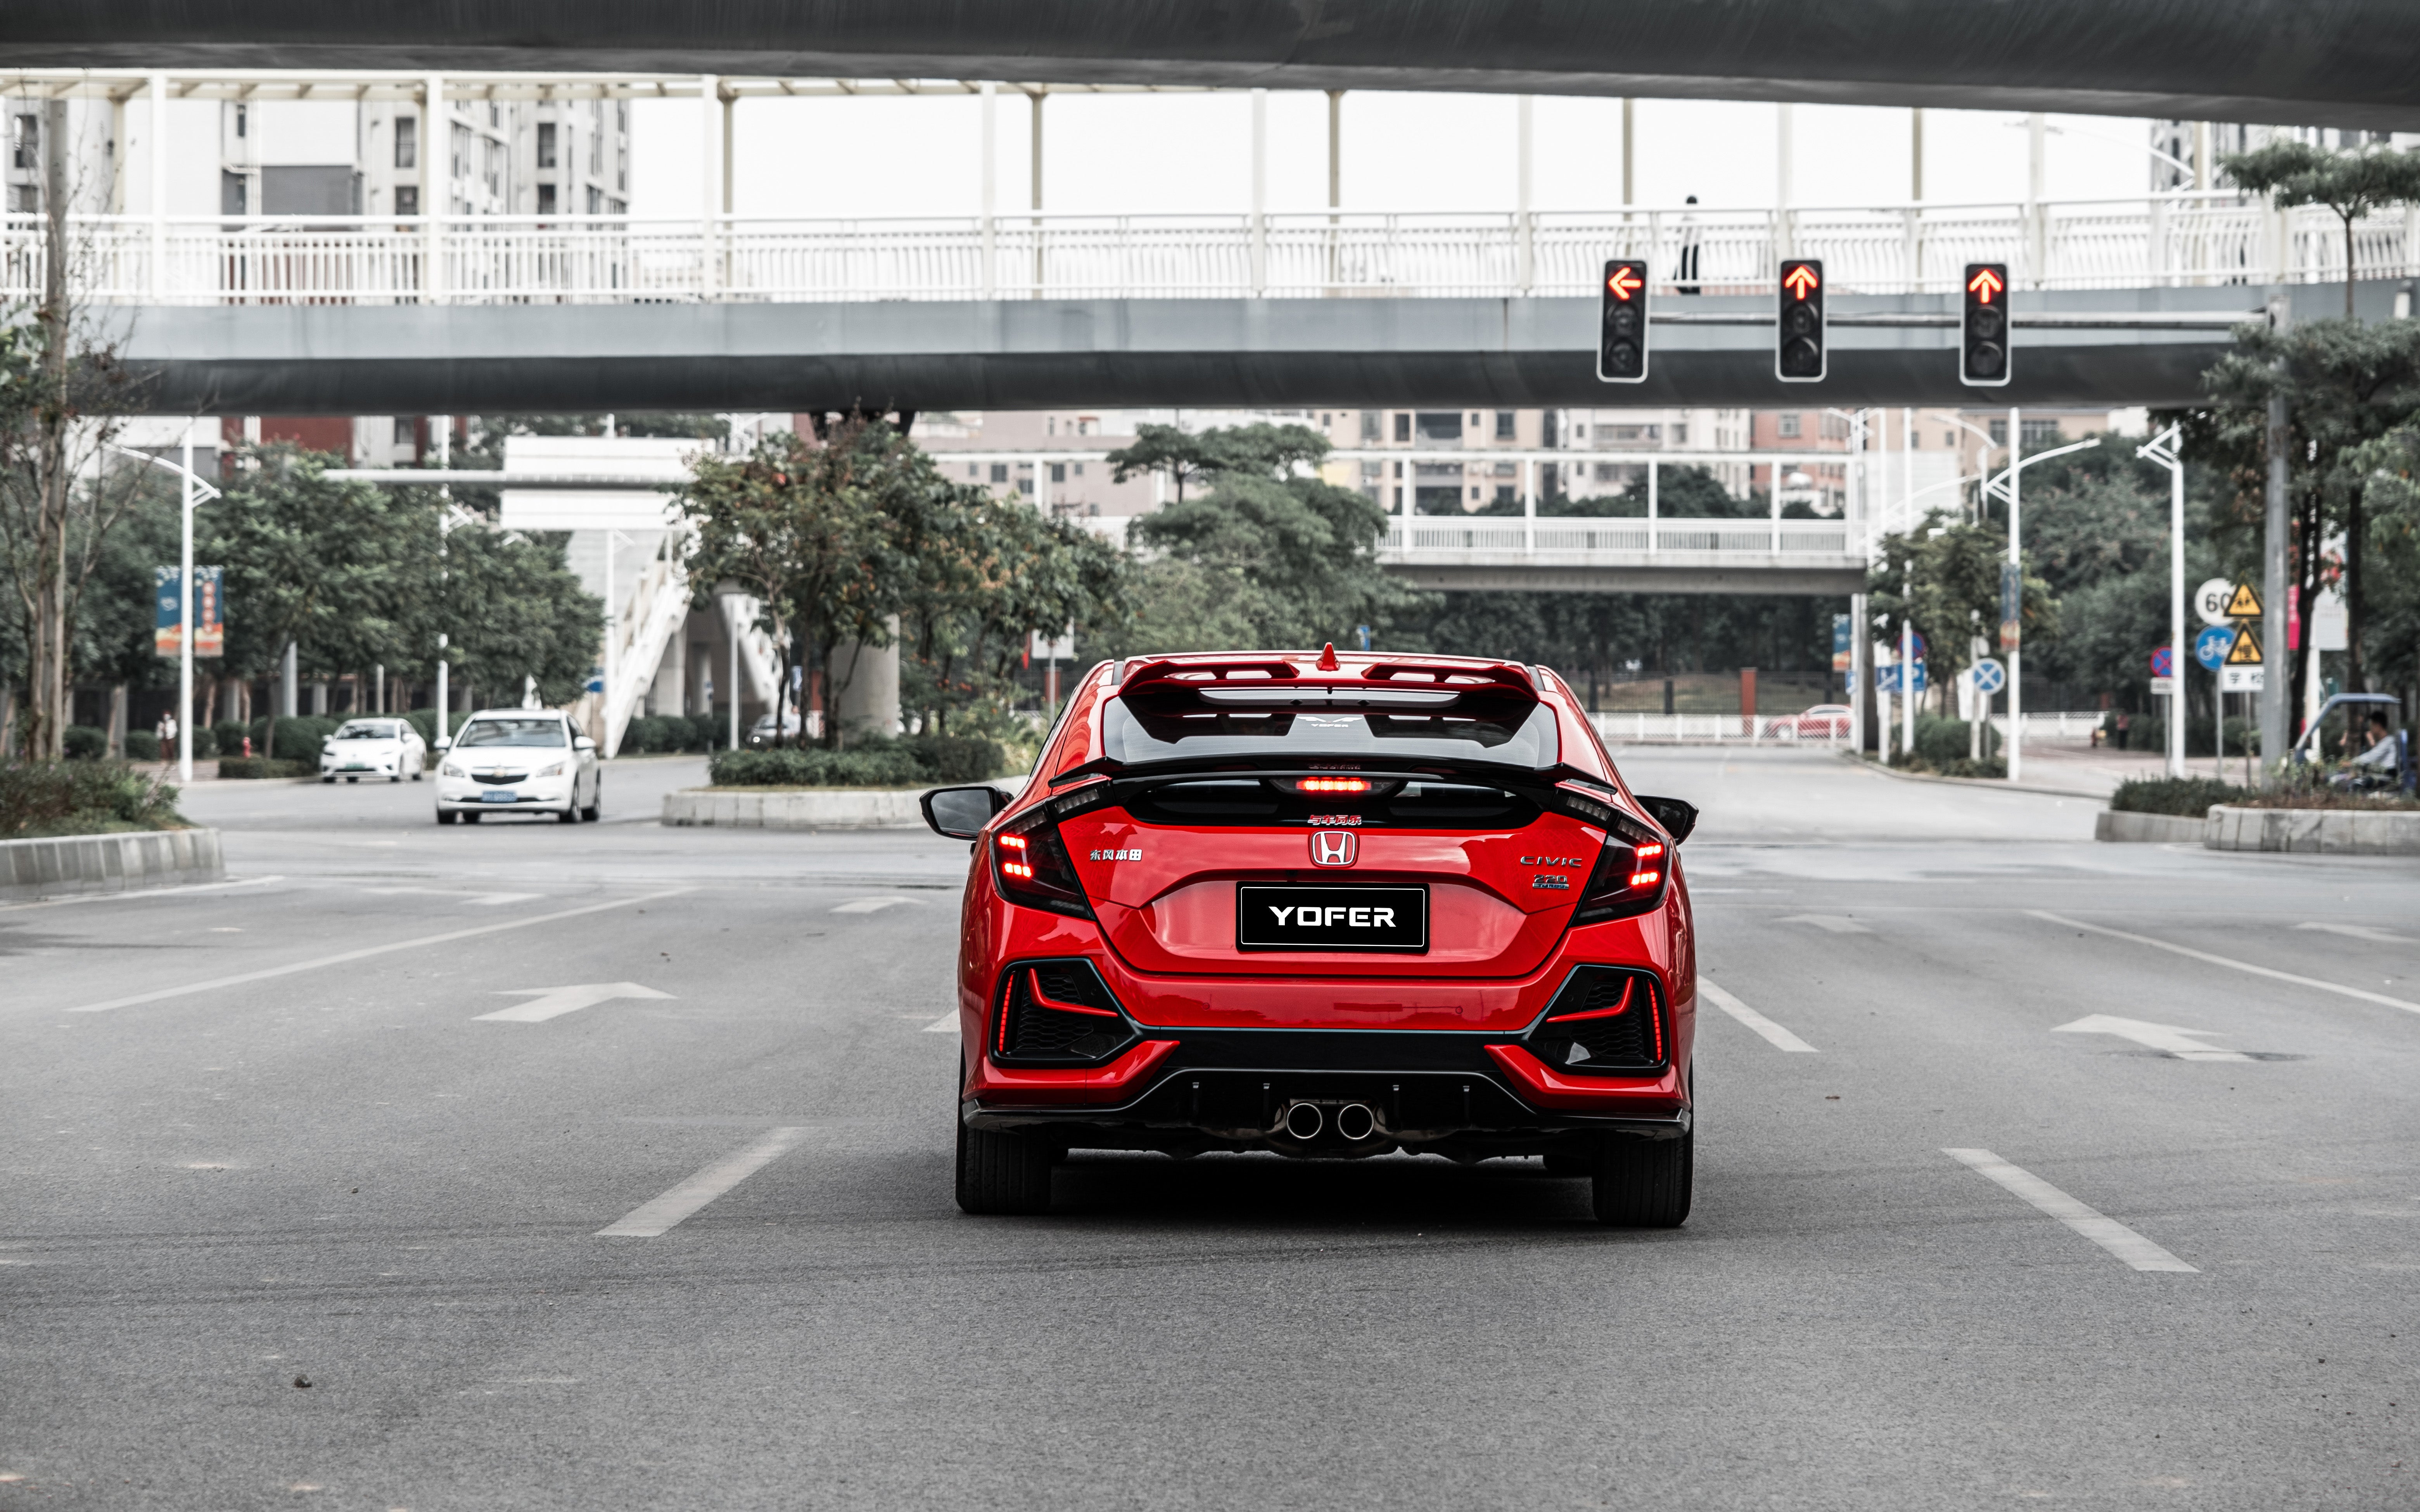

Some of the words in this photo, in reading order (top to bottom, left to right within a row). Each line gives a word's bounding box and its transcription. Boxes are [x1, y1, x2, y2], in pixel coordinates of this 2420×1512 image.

[2206, 593, 2231, 612] 60
[1307, 815, 1362, 825] 与车同乐
[1090, 849, 1142, 861] 东风本田
[1520, 856, 1582, 867] CIVIC
[1534, 874, 1567, 883] 220
[1269, 906, 1397, 927] YOFER
